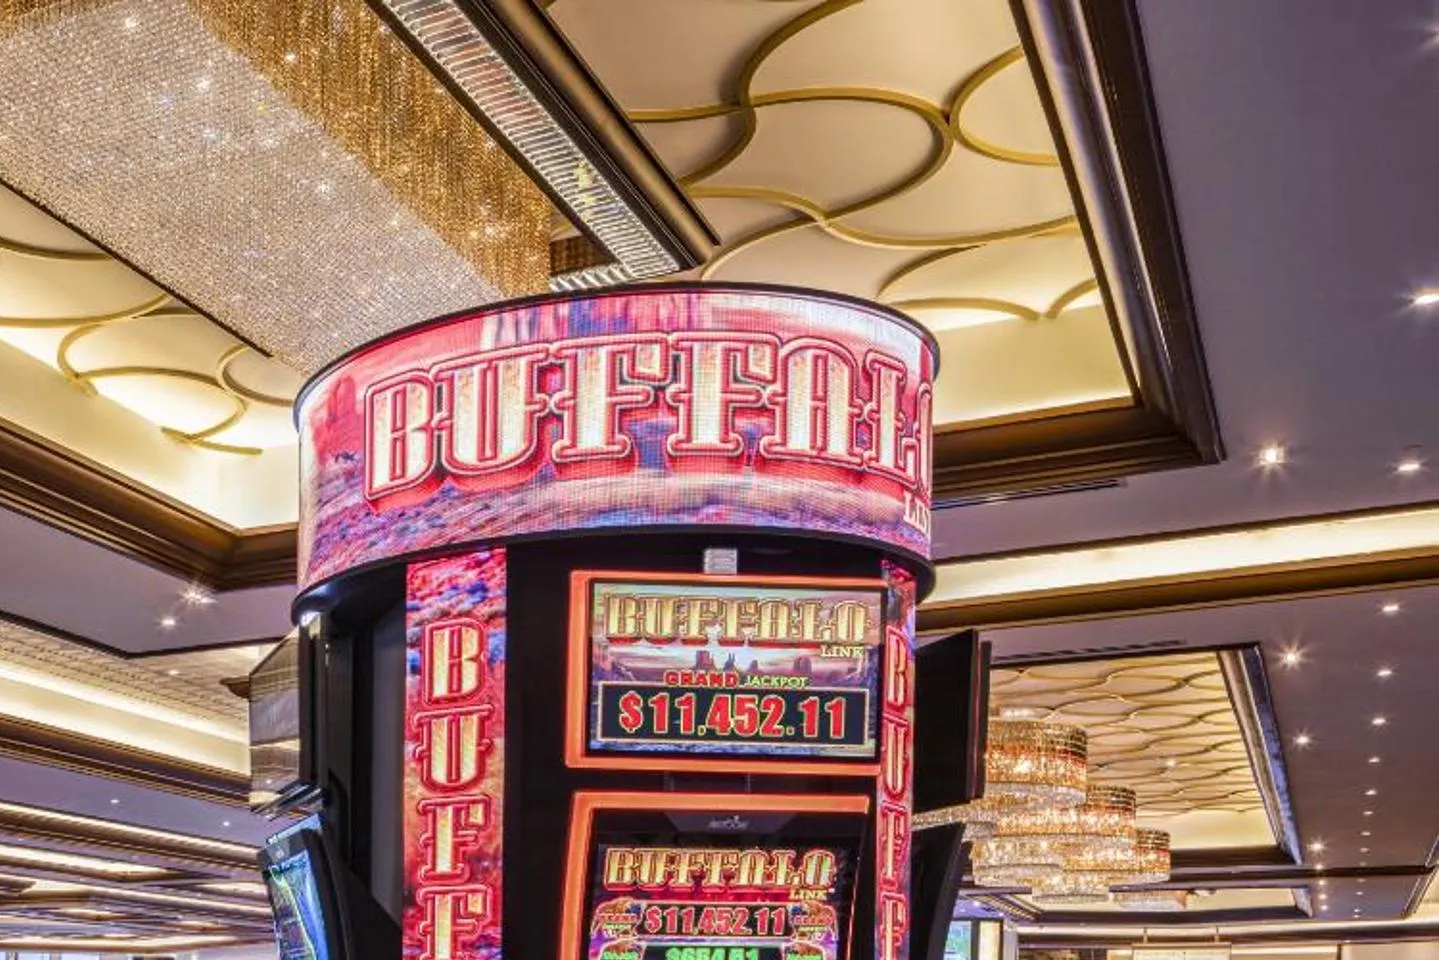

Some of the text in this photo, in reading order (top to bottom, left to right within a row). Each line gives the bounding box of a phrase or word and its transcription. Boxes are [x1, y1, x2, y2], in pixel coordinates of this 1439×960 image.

[603, 596, 872, 645] BUFFALO
[821, 645, 864, 658] LINK
[663, 670, 809, 688] GRAND JACKPOT
[617, 692, 848, 741] $11,452.11
[604, 847, 838, 891] BUFFALO
[789, 889, 828, 901] LINK
[643, 905, 786, 935] $11,452.11
